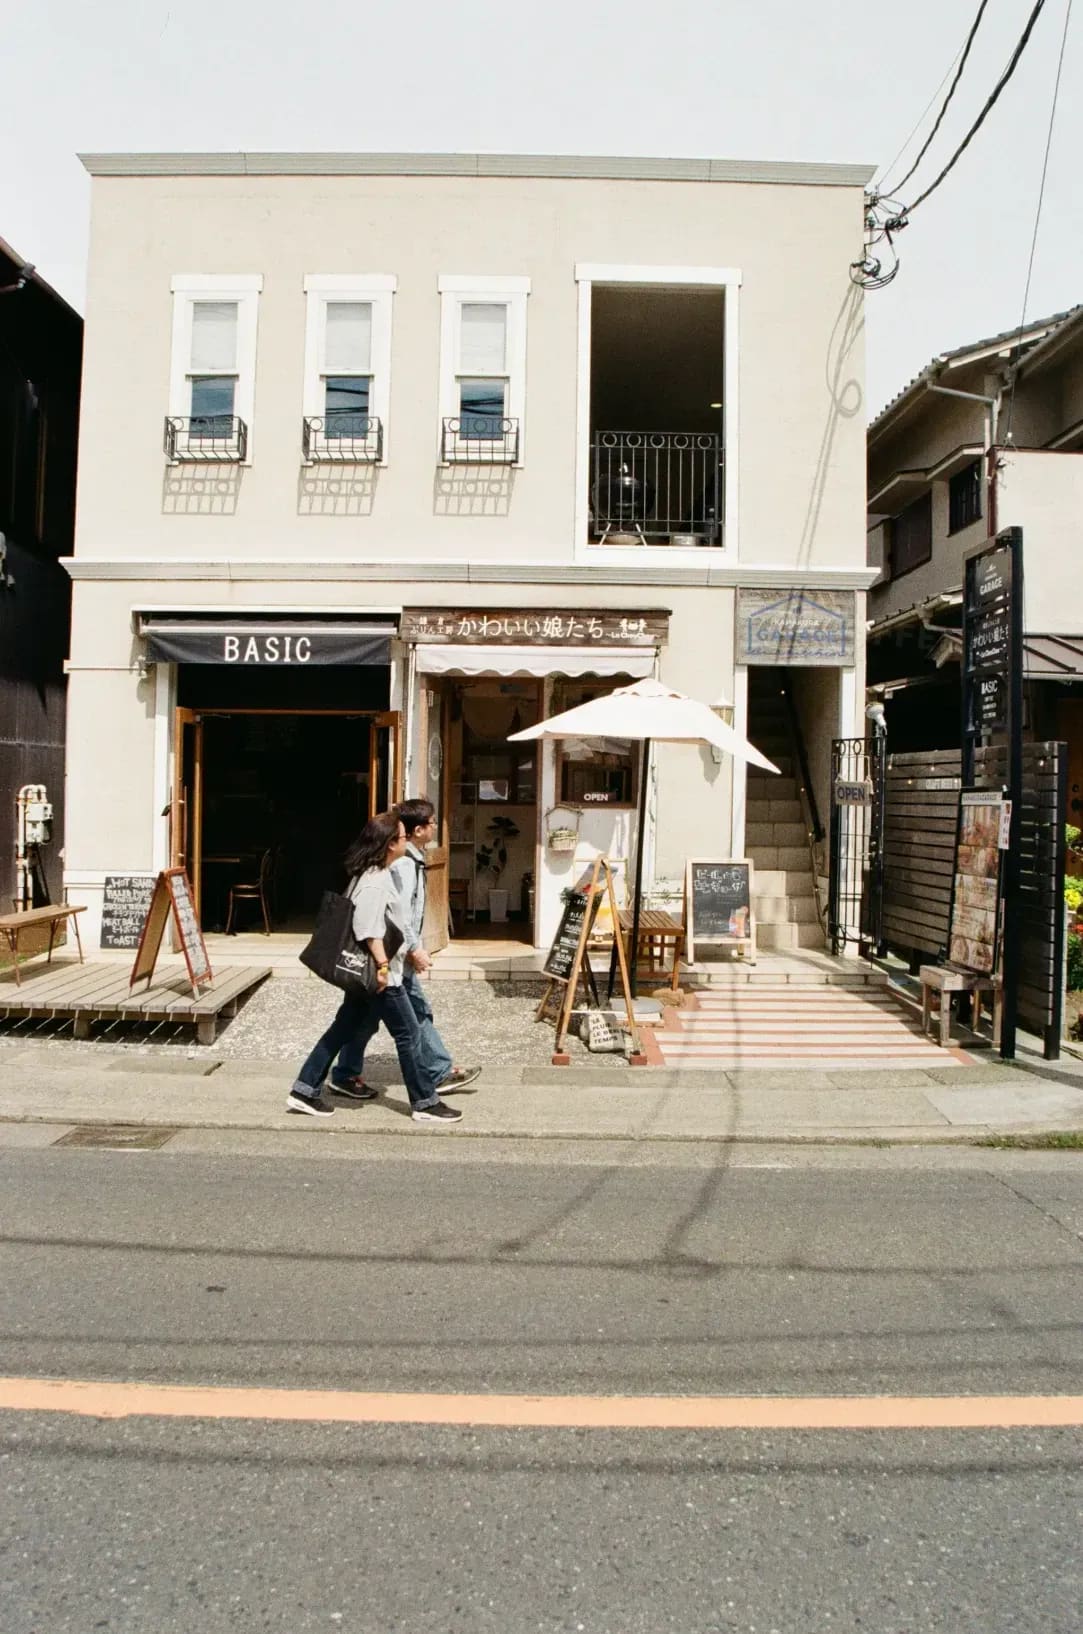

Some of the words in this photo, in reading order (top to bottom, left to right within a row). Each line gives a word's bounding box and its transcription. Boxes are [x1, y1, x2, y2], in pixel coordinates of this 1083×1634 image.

[979, 577, 1003, 596] GARAGE
[457, 615, 604, 639] かわいい娘たち
[224, 636, 311, 662] BASIC
[981, 680, 998, 694] BASIC
[584, 793, 608, 802] OPEN
[837, 786, 865, 800] OPEN
